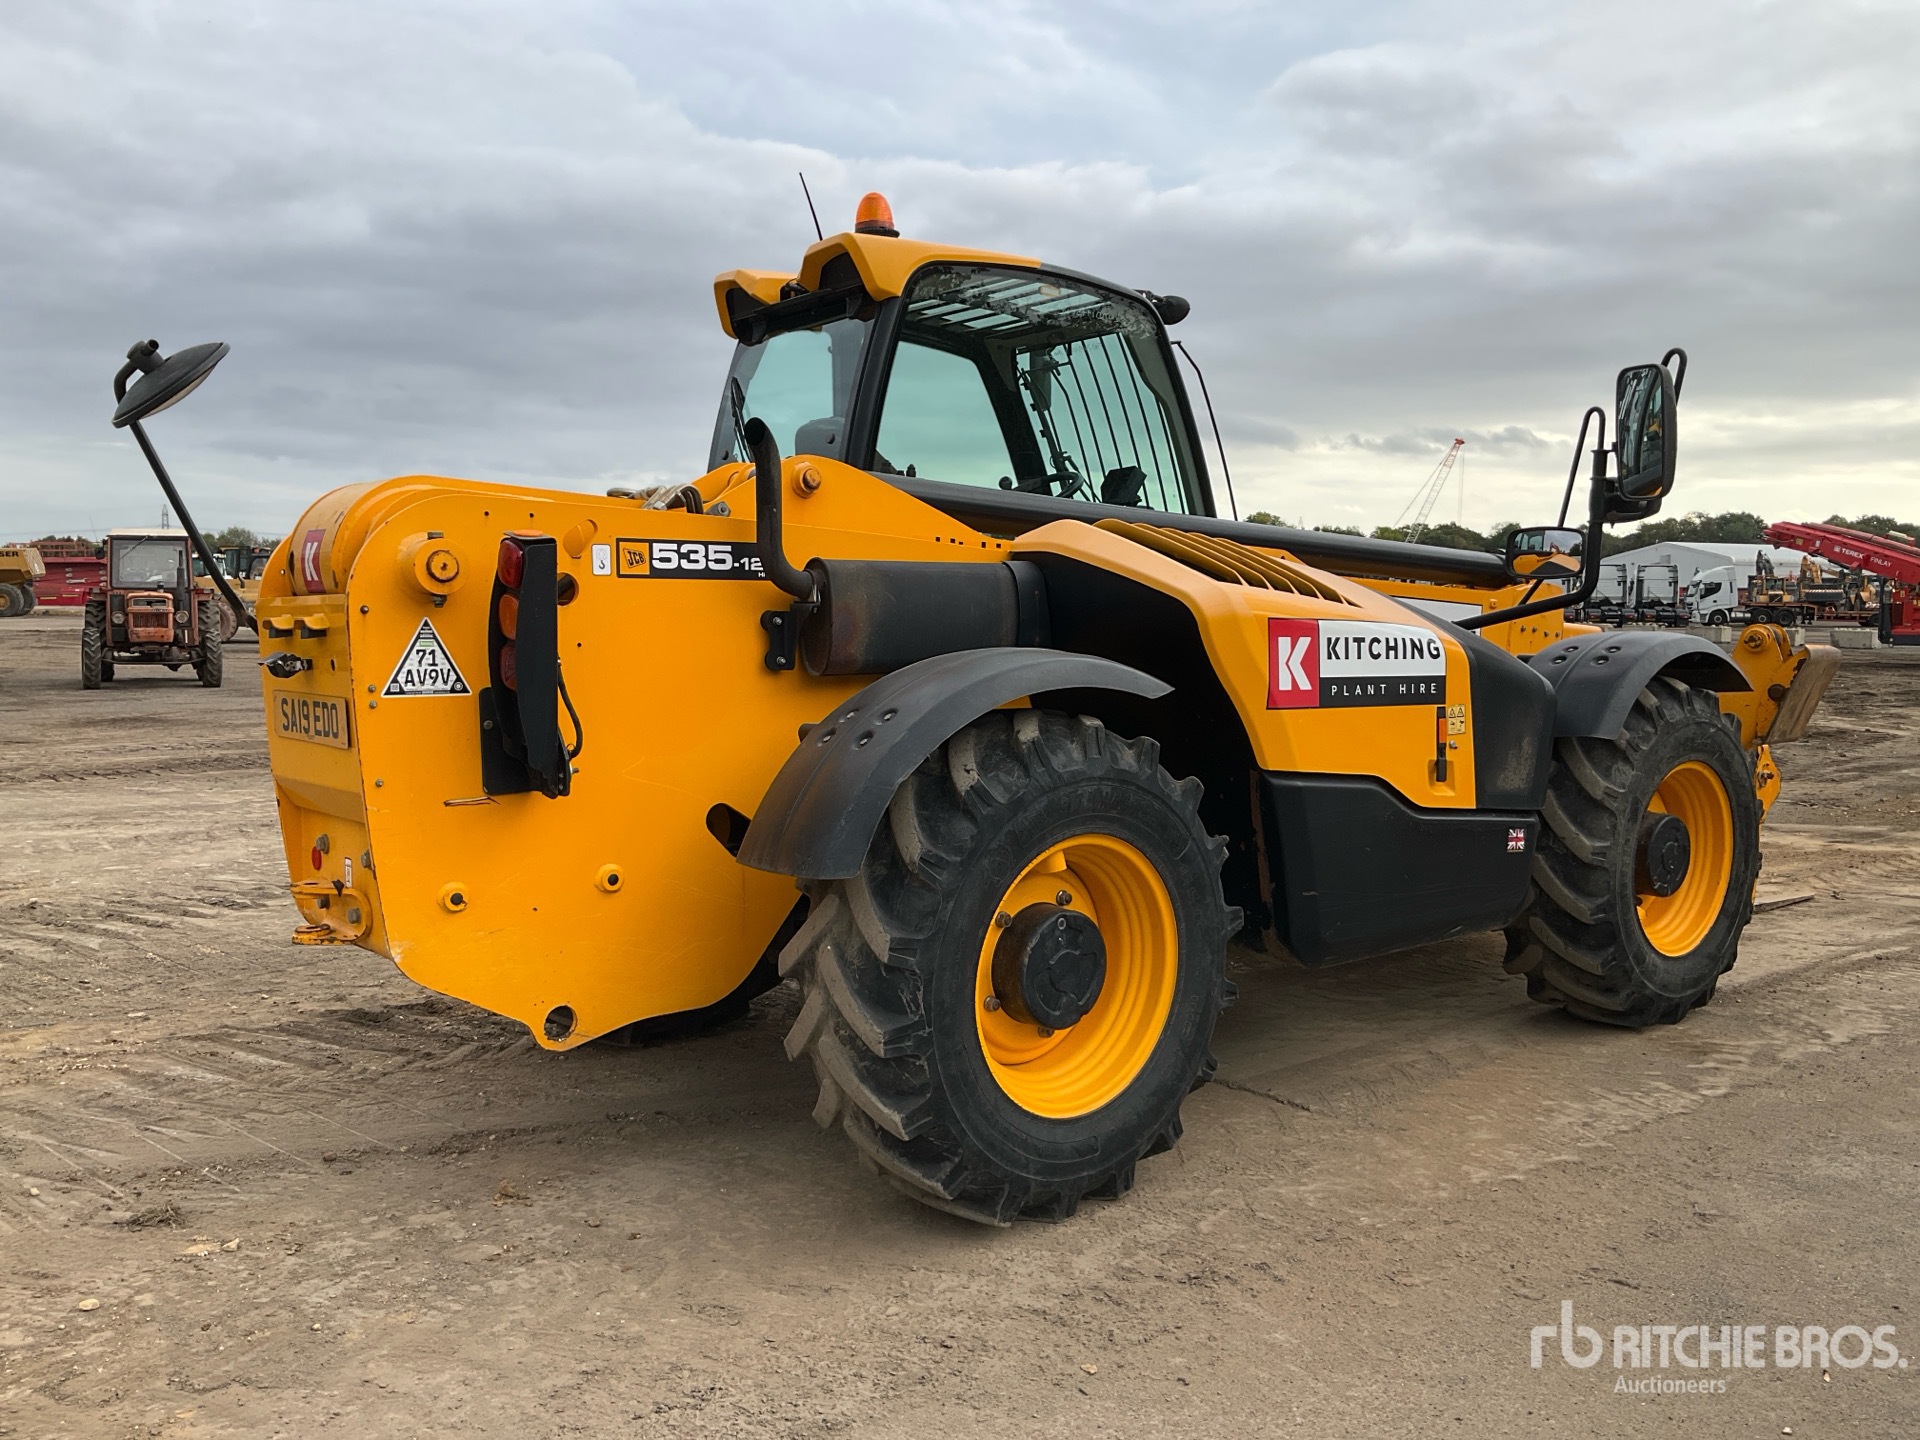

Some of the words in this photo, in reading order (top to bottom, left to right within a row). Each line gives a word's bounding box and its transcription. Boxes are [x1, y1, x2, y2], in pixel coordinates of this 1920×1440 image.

[305, 541, 319, 581] K
[627, 549, 645, 566] JCB
[652, 543, 764, 571] 535-12
[1842, 548, 1864, 560] TEREX
[1870, 556, 1892, 567] FINLAY
[416, 649, 438, 667] 71
[1326, 636, 1441, 661] KITCHING
[1278, 636, 1312, 691] K
[404, 668, 451, 687] AV9V
[1331, 684, 1387, 696] PLANT
[1399, 683, 1437, 695] HIRE
[281, 697, 310, 734] SA19
[313, 700, 339, 739] EDO
